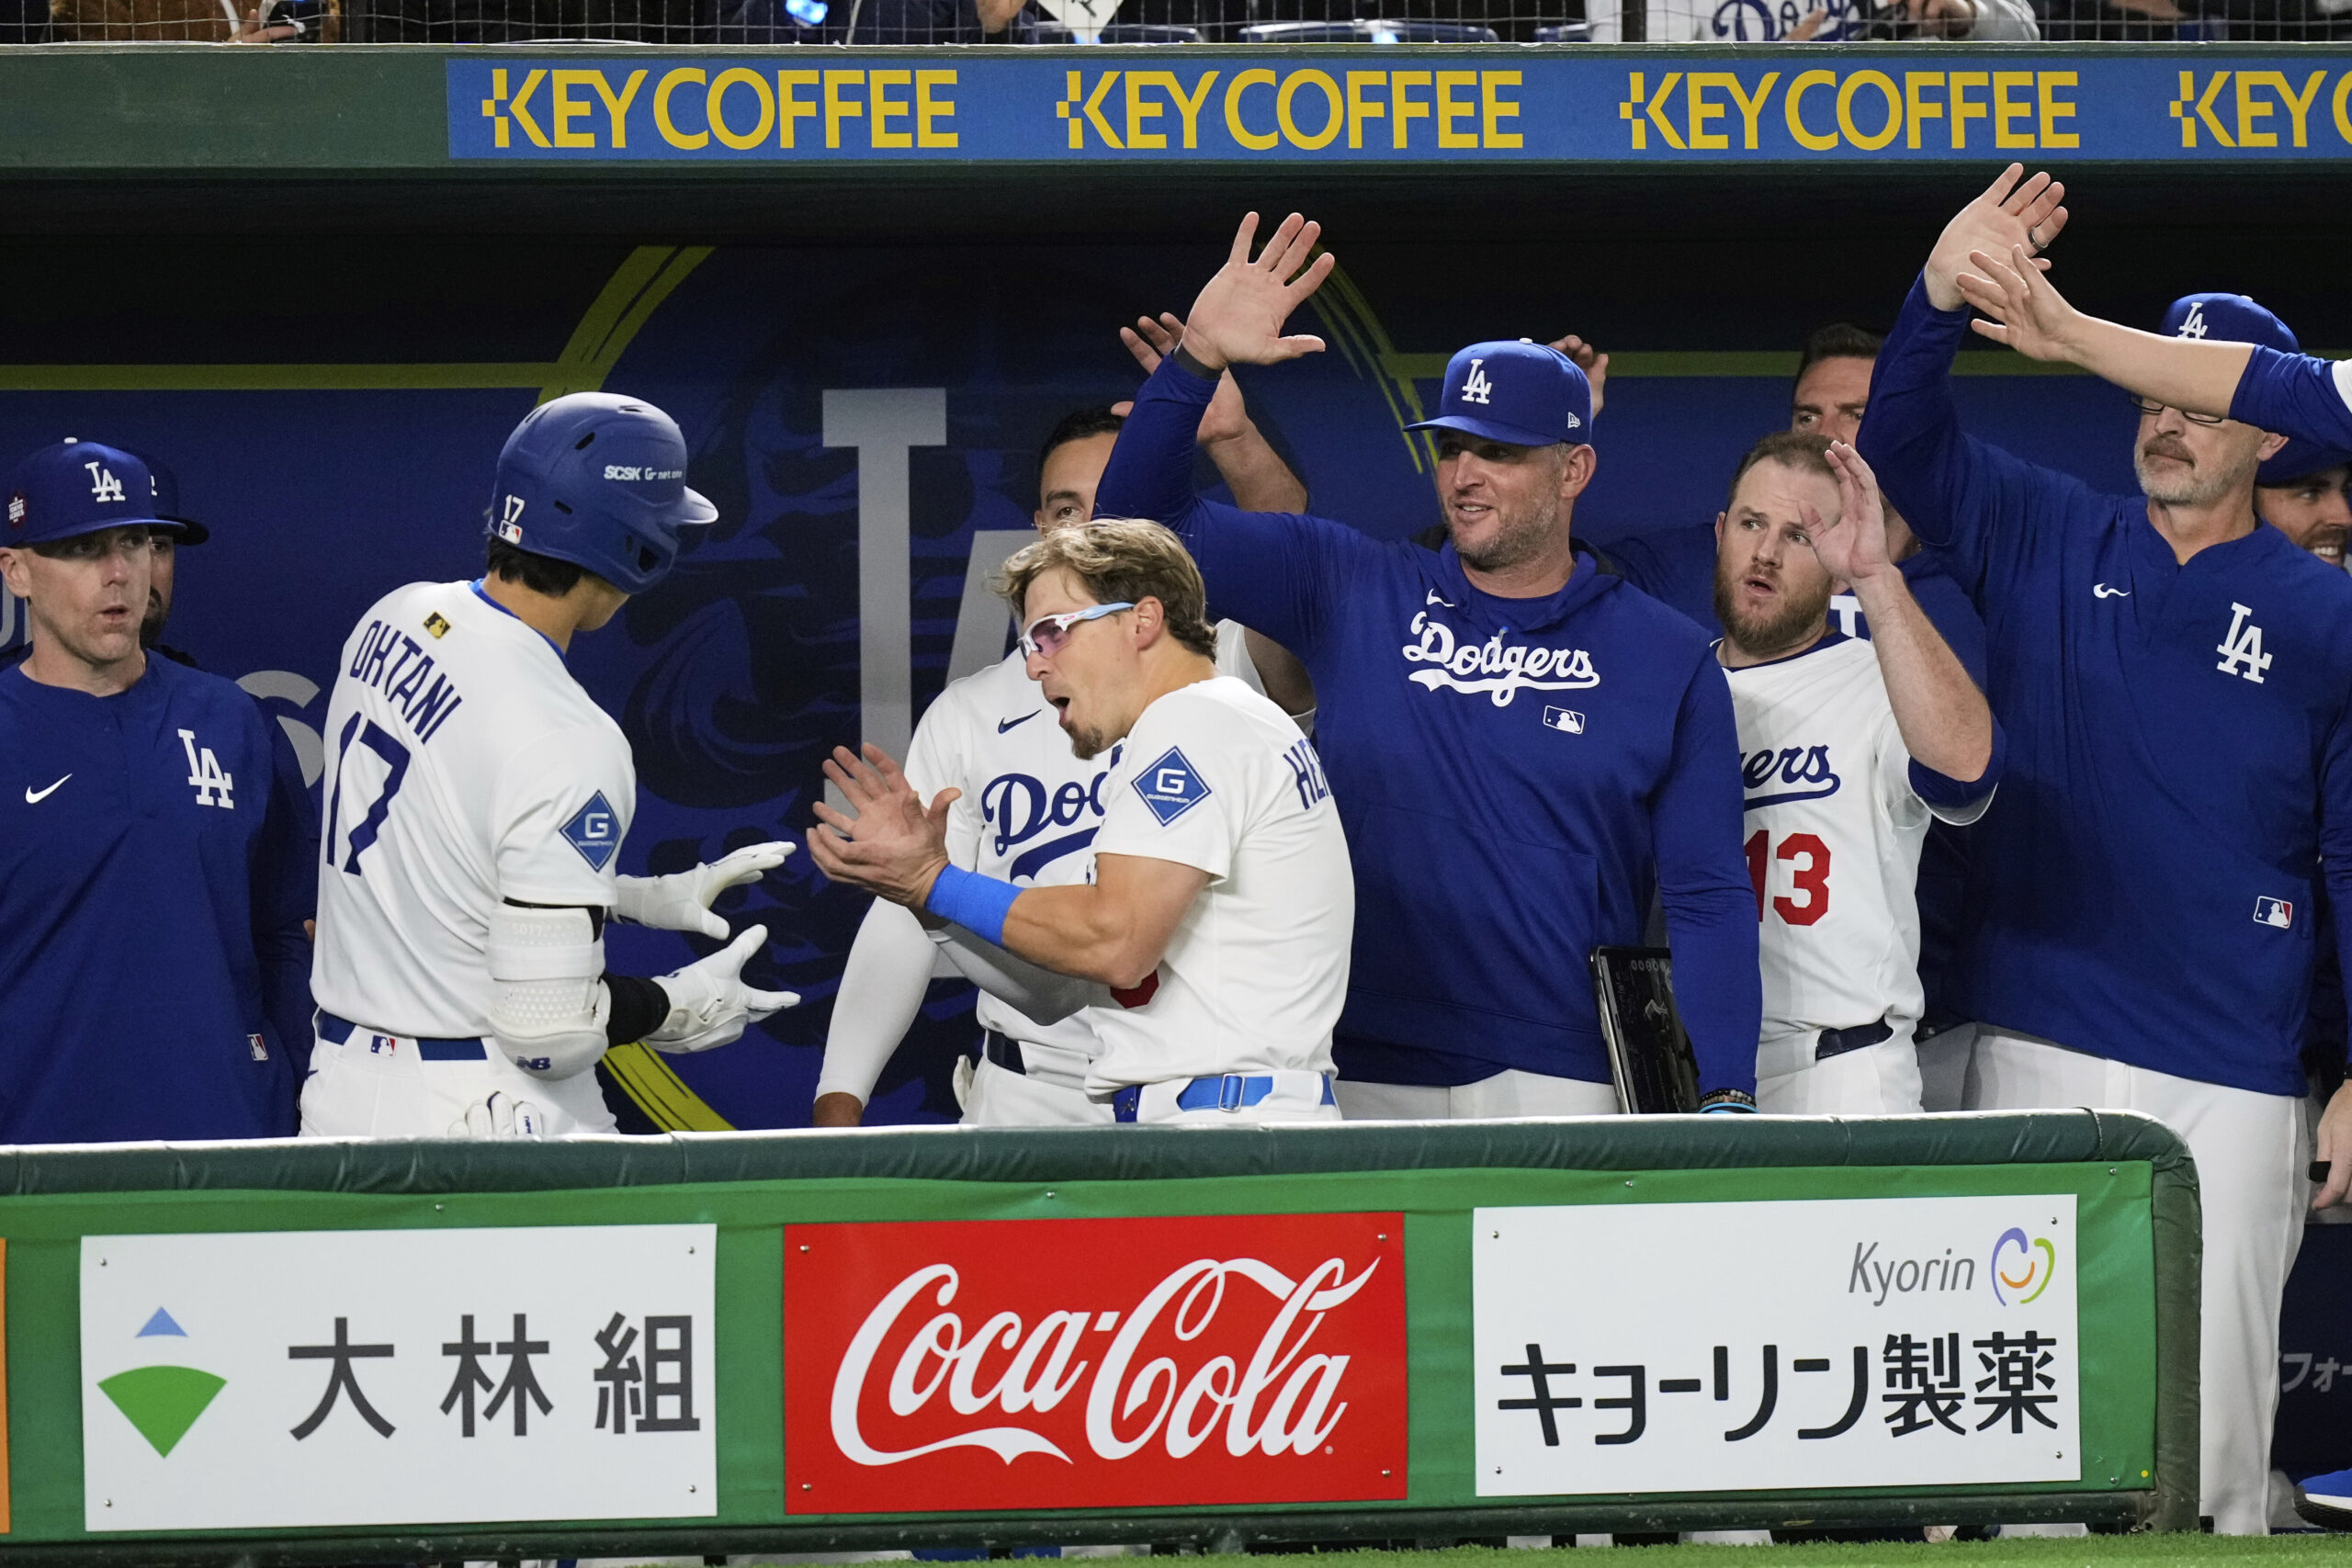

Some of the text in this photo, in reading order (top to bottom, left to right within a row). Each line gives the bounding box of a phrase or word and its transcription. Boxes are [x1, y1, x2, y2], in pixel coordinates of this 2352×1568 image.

[481, 67, 958, 150] KEY COFFEE
[1056, 68, 1523, 151] KEY COFFEE
[1619, 69, 2080, 151] KEY COFFEE
[2169, 70, 2328, 147] KEY
[2177, 301, 2209, 339] LA
[1462, 358, 1493, 404] LA
[85, 461, 126, 502] LA
[504, 494, 526, 523] 17
[604, 465, 641, 480] SCSK
[349, 620, 463, 746] OHTANI
[1402, 611, 1600, 707] Dodgers
[2217, 602, 2273, 684] LA
[177, 728, 234, 809] LA
[326, 711, 412, 876] 17
[1156, 768, 1187, 795] G
[1739, 744, 1840, 790] ers
[585, 813, 609, 839] G
[1744, 829, 1831, 926] 13
[1849, 1242, 1975, 1307] Kyorin
[288, 1311, 701, 1442] 大林組
[830, 1256, 1381, 1467] Coca-Cola
[1497, 1330, 2059, 1448] キョーリン製薬
